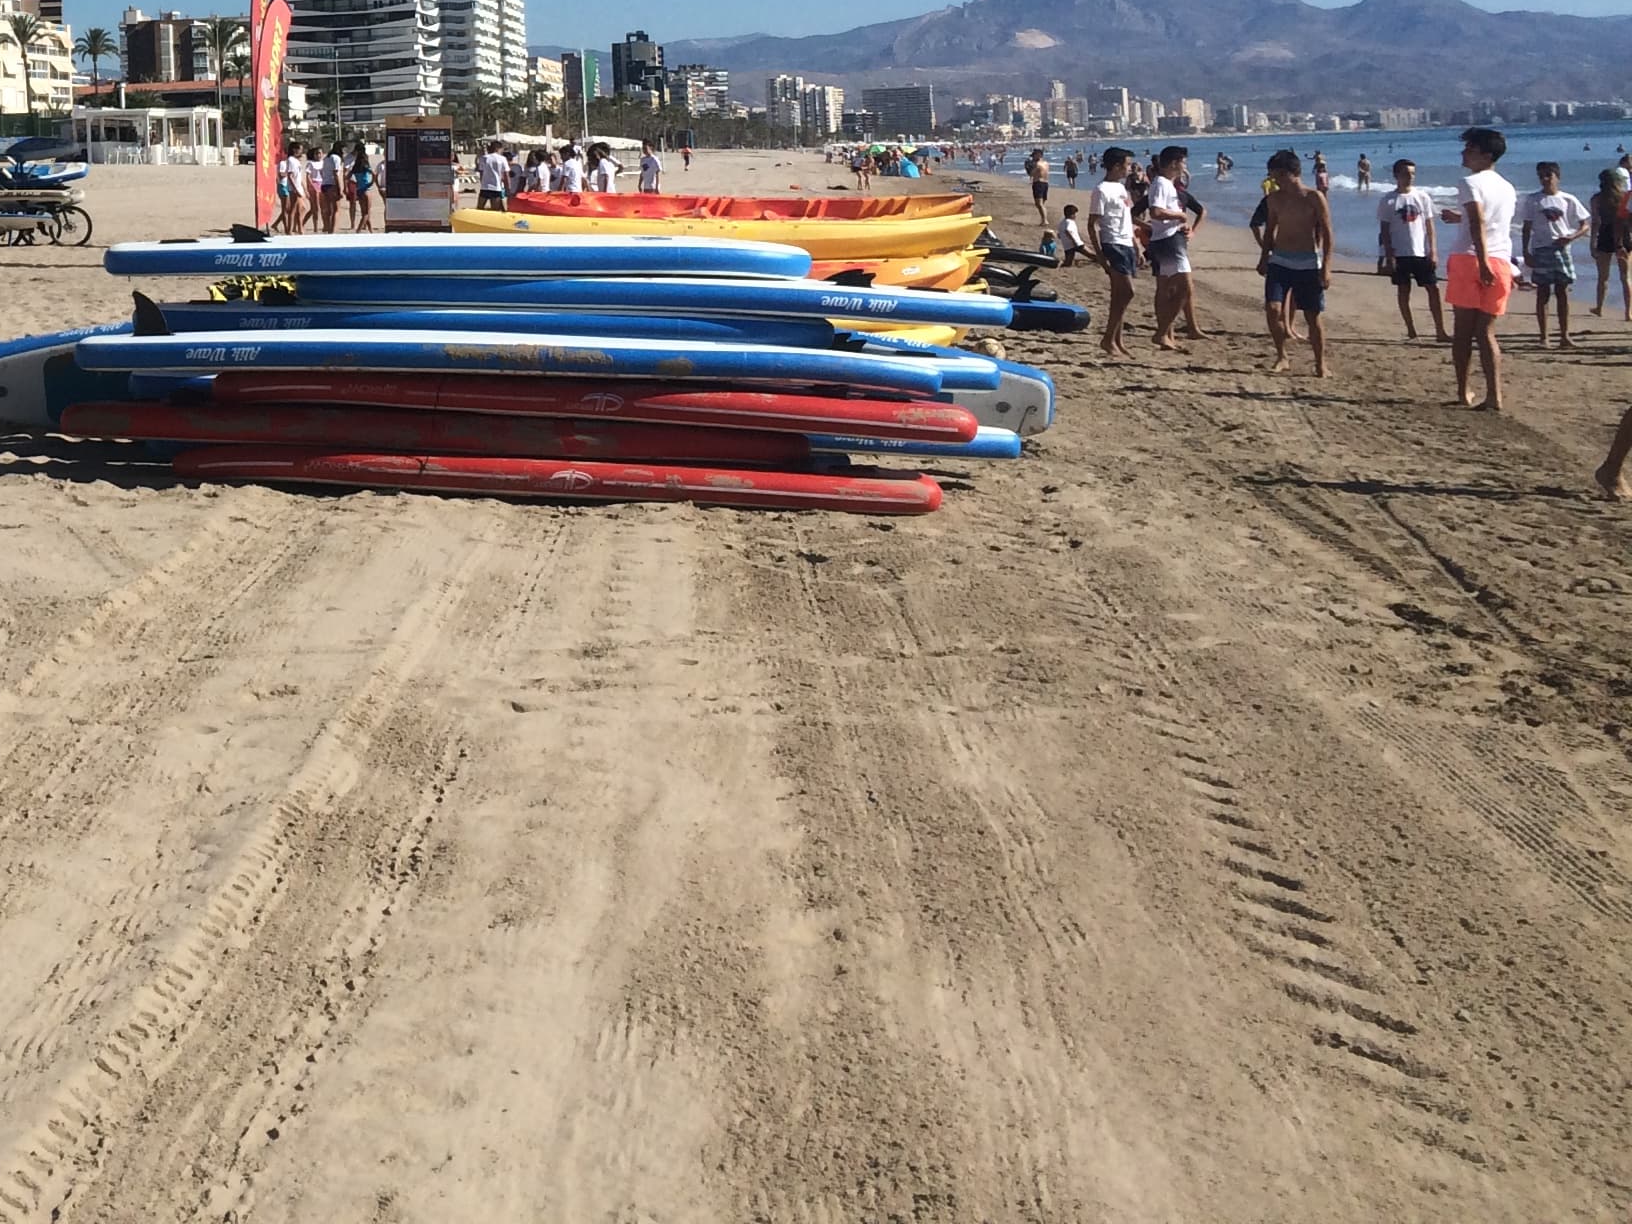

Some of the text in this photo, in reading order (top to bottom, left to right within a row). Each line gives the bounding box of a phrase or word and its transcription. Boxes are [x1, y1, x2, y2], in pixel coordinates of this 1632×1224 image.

[214, 253, 254, 267] Wave
[821, 295, 863, 311] Wave
[185, 347, 226, 362] Wave
